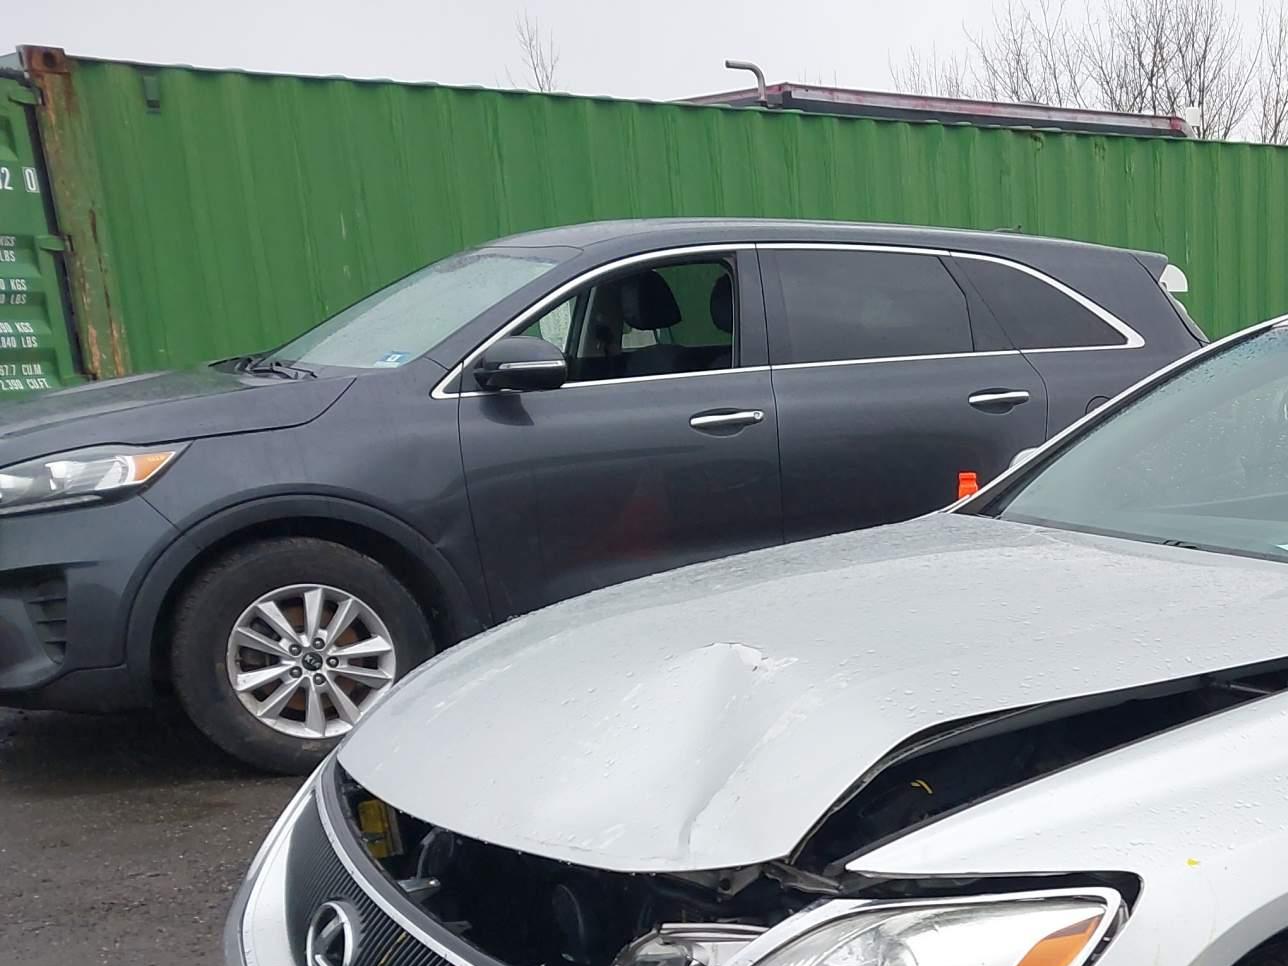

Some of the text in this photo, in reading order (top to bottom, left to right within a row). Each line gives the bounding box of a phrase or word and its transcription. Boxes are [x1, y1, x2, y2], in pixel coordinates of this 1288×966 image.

[0, 167, 37, 191] 2 0
[10, 279, 27, 291] KGS
[15, 321, 34, 333] KGS
[21, 336, 39, 348] LBS
[305, 654, 321, 668] KIA
